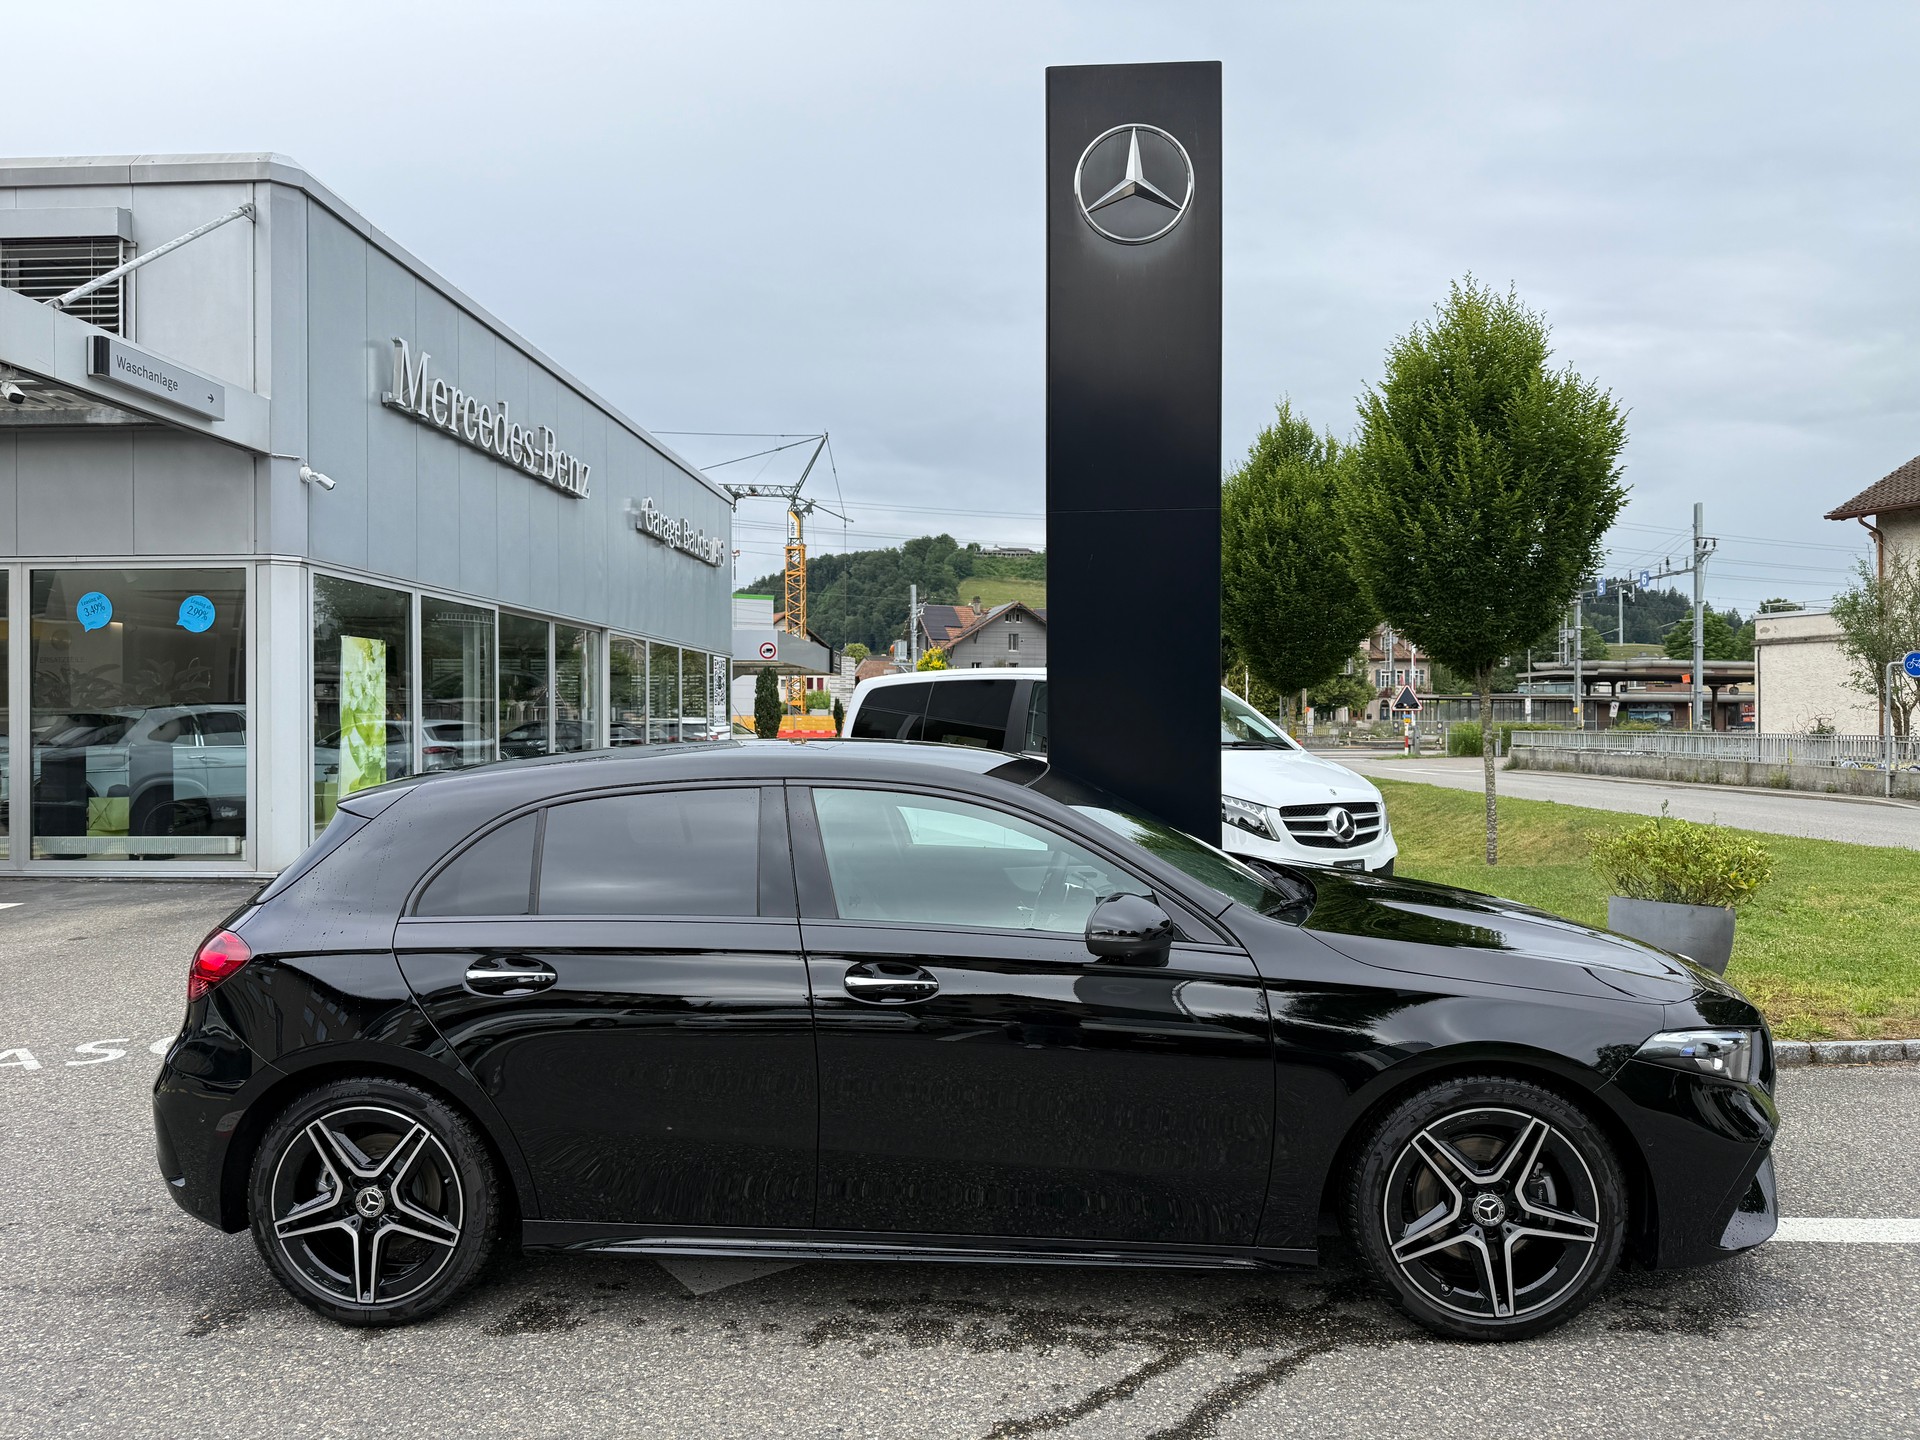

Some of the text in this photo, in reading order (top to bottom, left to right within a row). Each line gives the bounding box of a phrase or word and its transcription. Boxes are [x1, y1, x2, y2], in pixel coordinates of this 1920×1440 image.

[116, 354, 179, 392] Waschanlage
[391, 337, 591, 499] Mercedes-Benz
[642, 497, 681, 549] Garage
[1599, 582, 1604, 593] 5
[1641, 574, 1647, 585] 6
[83, 601, 106, 617] 3.49%
